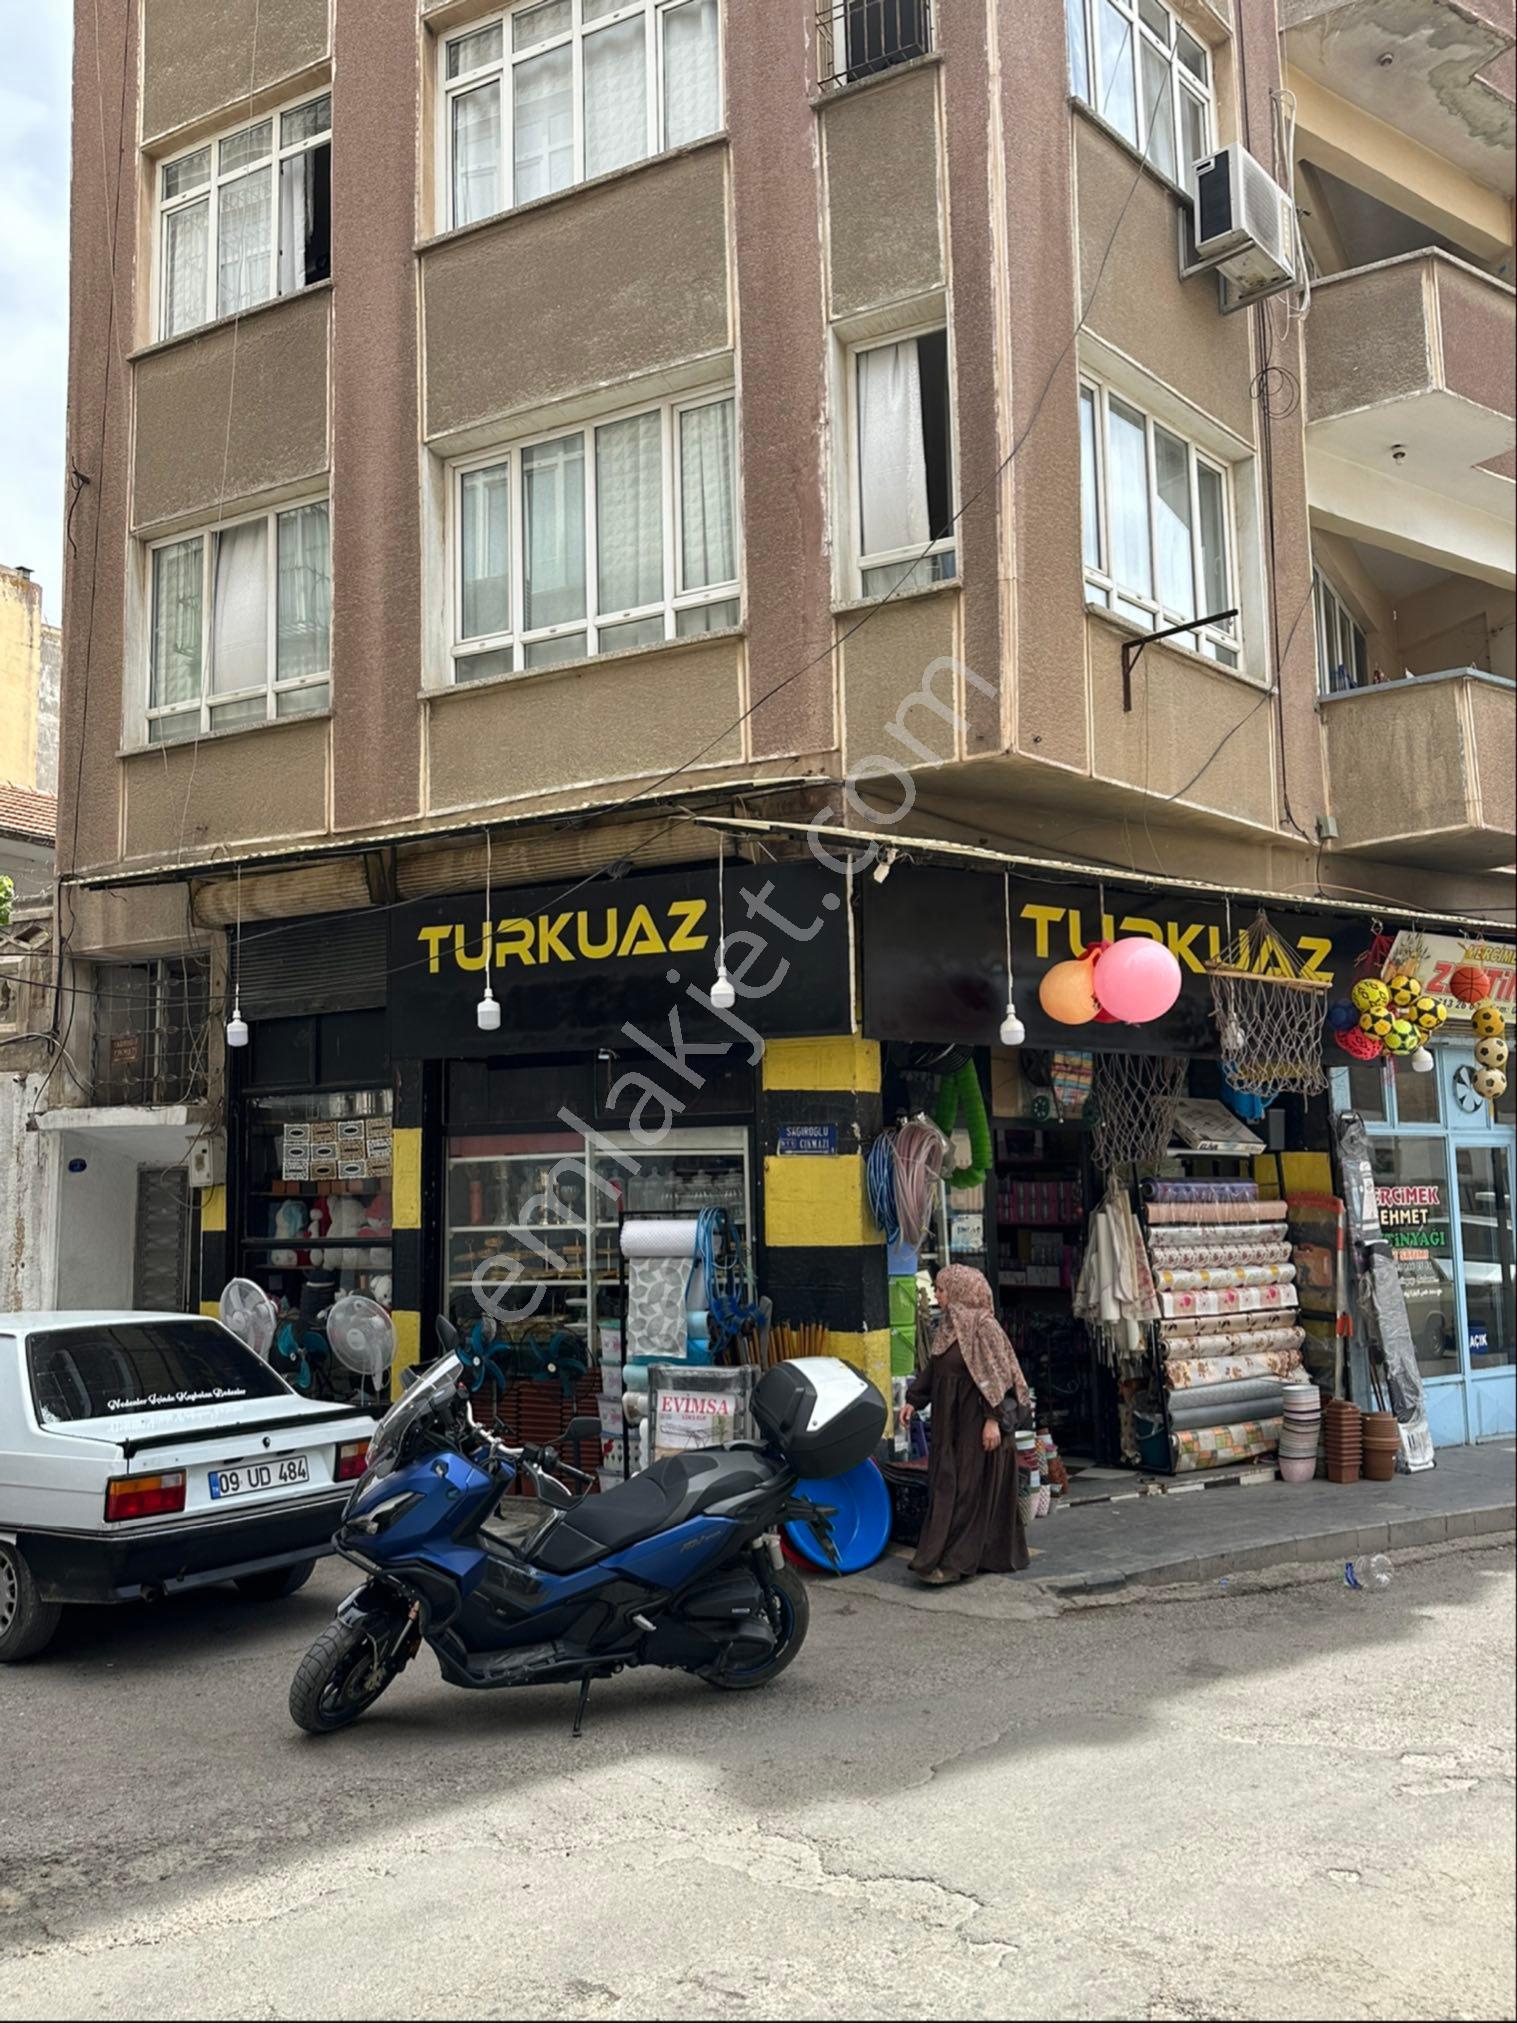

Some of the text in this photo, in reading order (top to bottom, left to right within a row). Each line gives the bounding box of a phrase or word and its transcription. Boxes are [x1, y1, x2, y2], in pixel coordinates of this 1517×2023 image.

[417, 899, 709, 973] TURKUAZ
[1375, 1186, 1439, 1207] ERCİMEK
[1380, 1209, 1428, 1225] EHMET
[1470, 1334, 1488, 1349] AÇIK
[662, 1393, 729, 1415] EVİMSA
[219, 1459, 306, 1493] 09 UD 484
